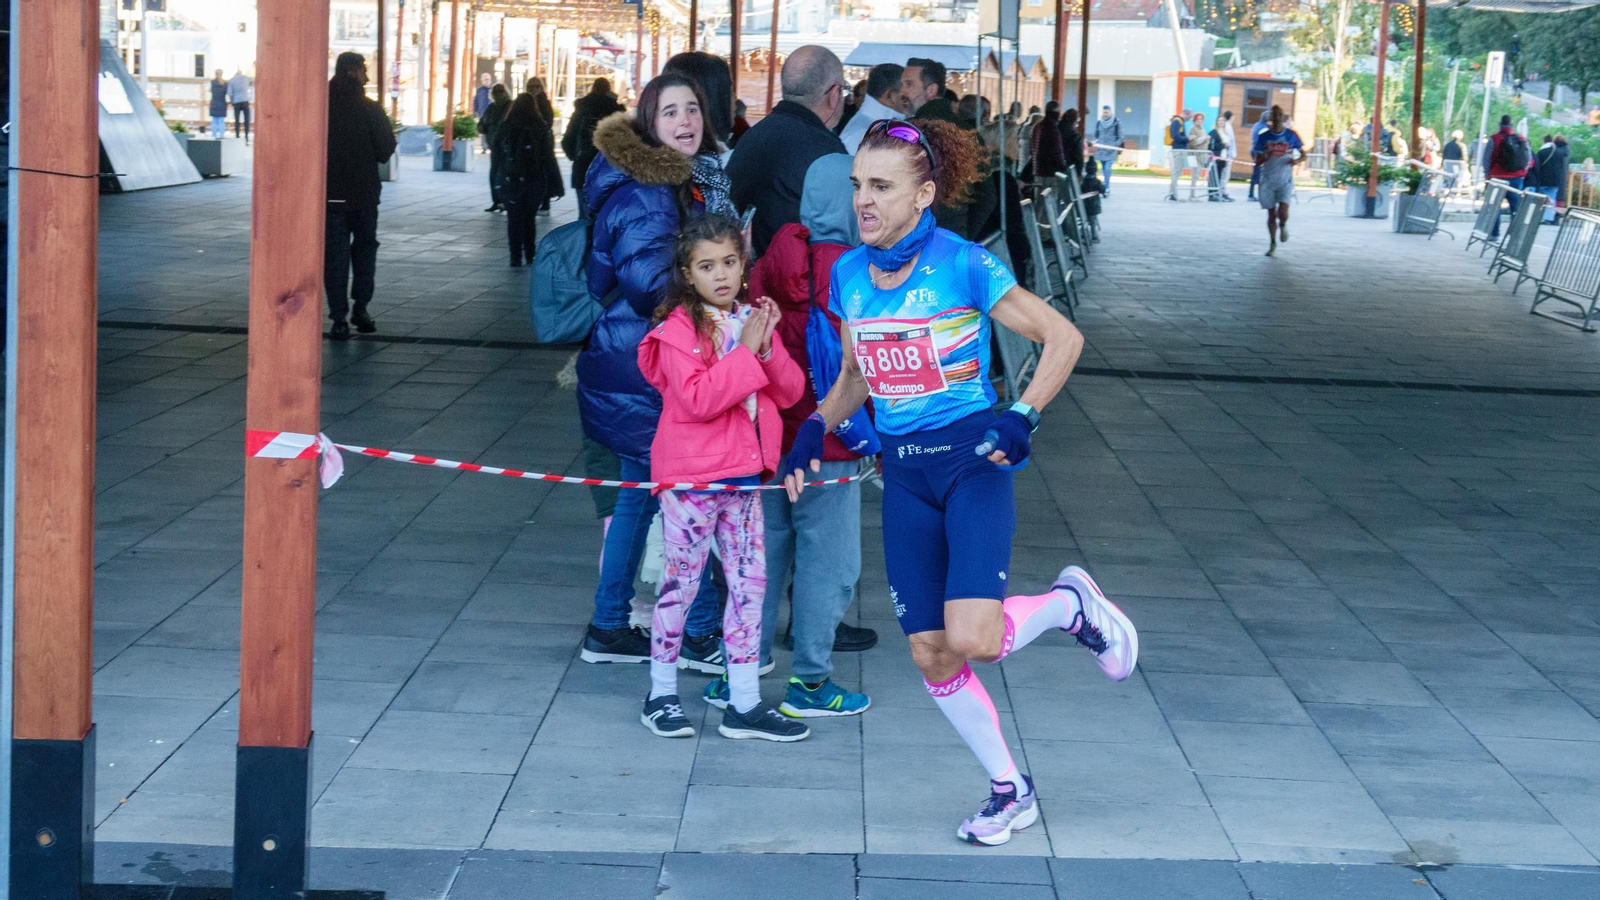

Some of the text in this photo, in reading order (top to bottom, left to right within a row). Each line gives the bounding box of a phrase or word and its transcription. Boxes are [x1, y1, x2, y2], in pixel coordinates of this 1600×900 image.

[876, 345, 922, 372] 808
[879, 381, 925, 394] Alcampo
[923, 445, 951, 454] seguros
